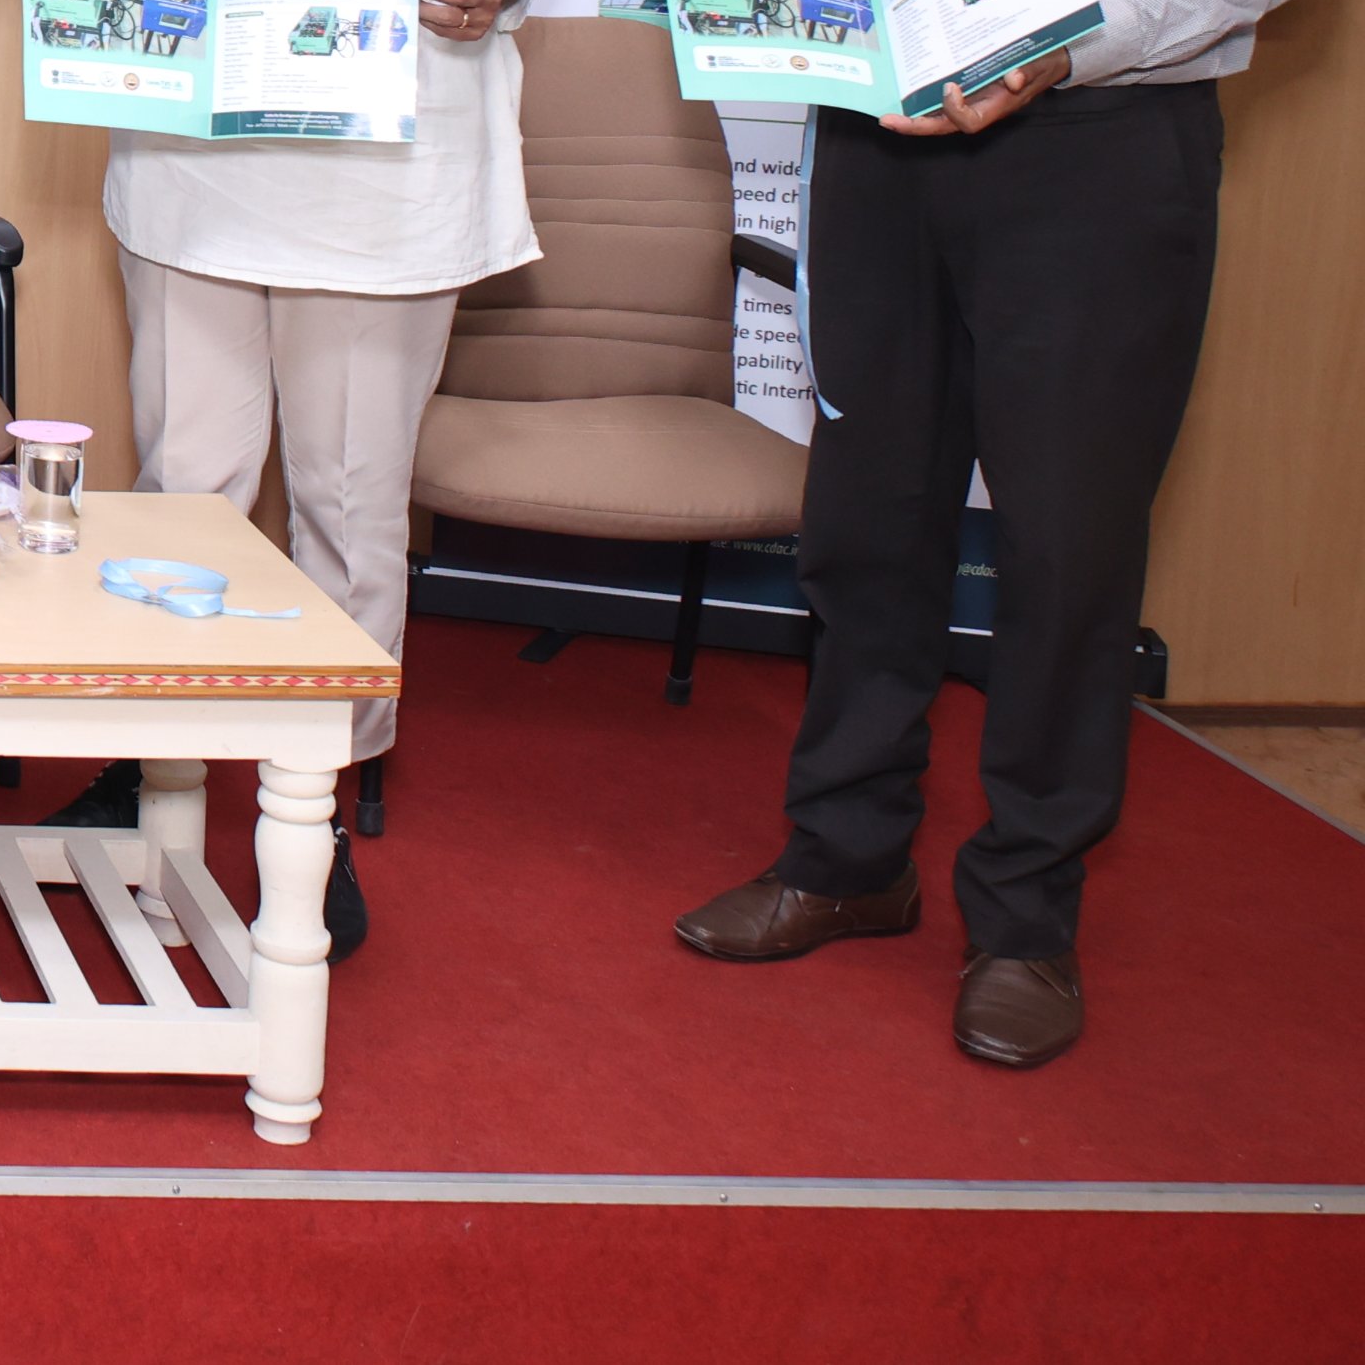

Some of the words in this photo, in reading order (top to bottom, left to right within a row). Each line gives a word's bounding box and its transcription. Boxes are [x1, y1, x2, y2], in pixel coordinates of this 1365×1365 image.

[736, 214, 753, 228] in
[758, 214, 797, 234] high
[743, 298, 792, 315] times
